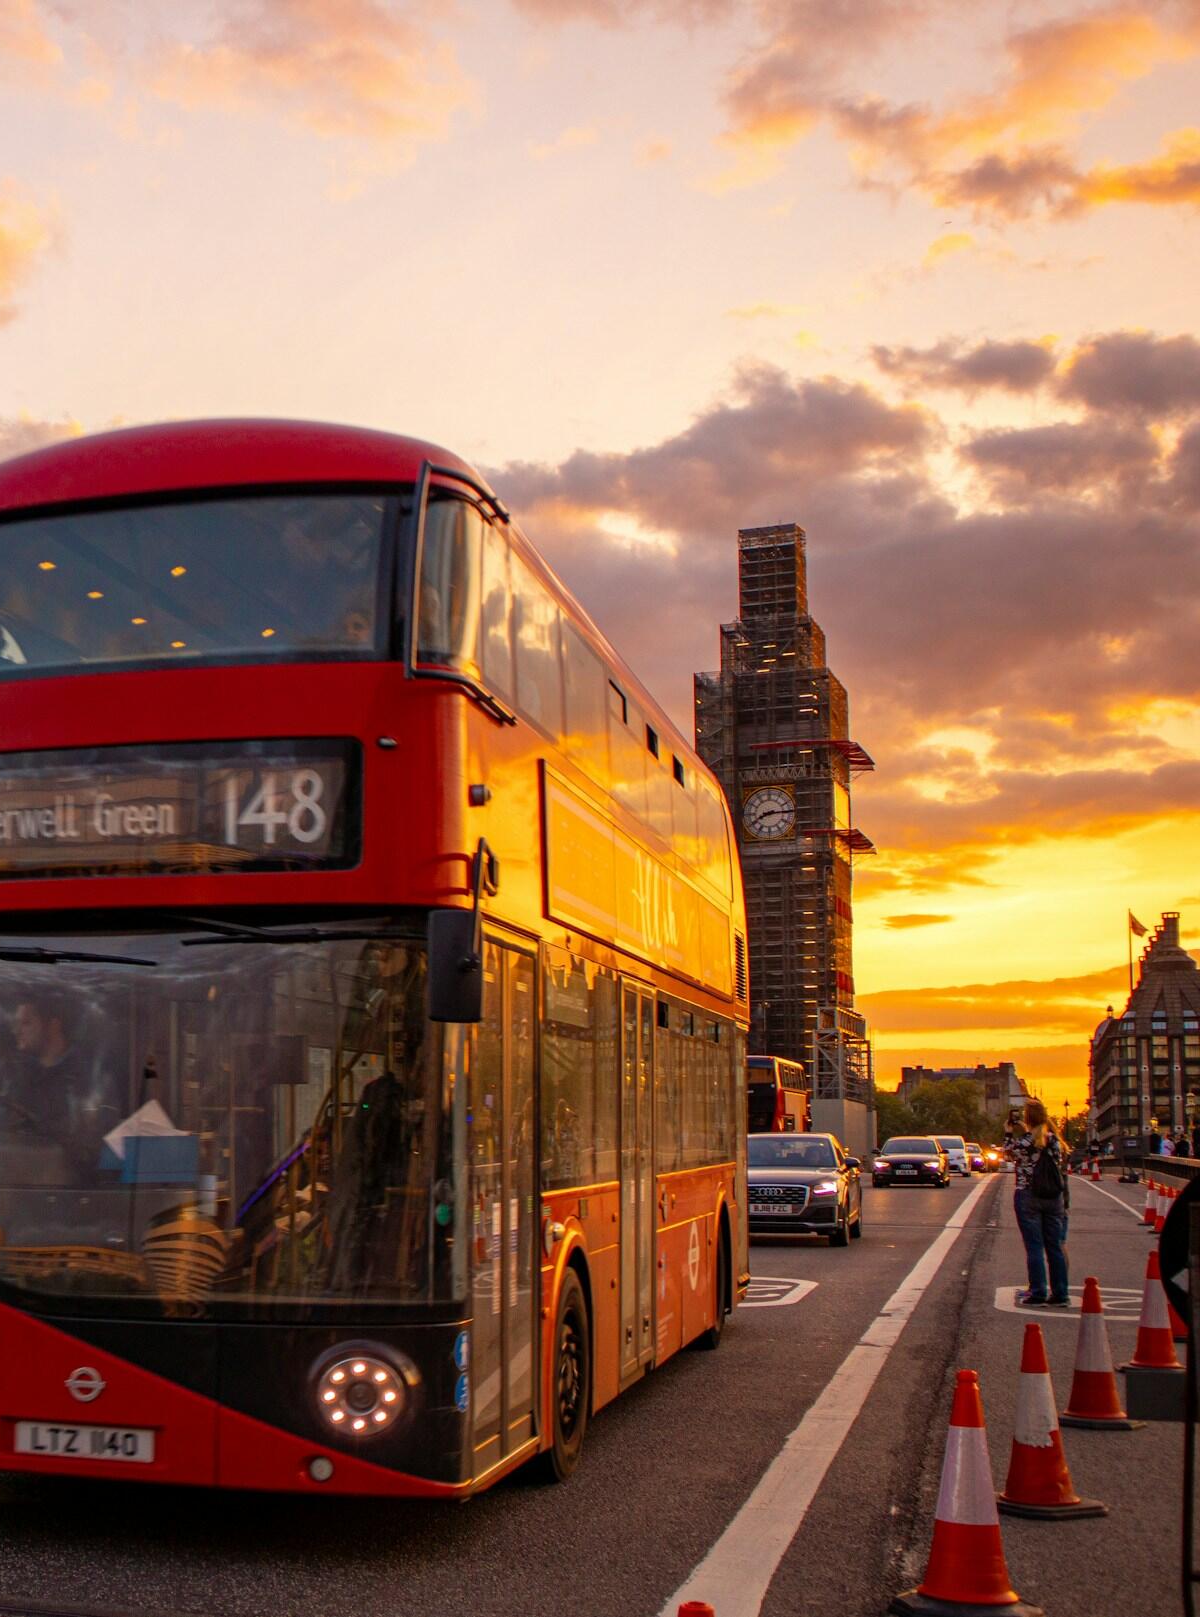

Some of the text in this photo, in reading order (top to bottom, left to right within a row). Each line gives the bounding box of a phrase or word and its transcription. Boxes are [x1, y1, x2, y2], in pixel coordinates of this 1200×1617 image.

[93, 793, 176, 837] Green
[223, 769, 327, 846] 148
[31, 1426, 139, 1457] LTZ 1140
